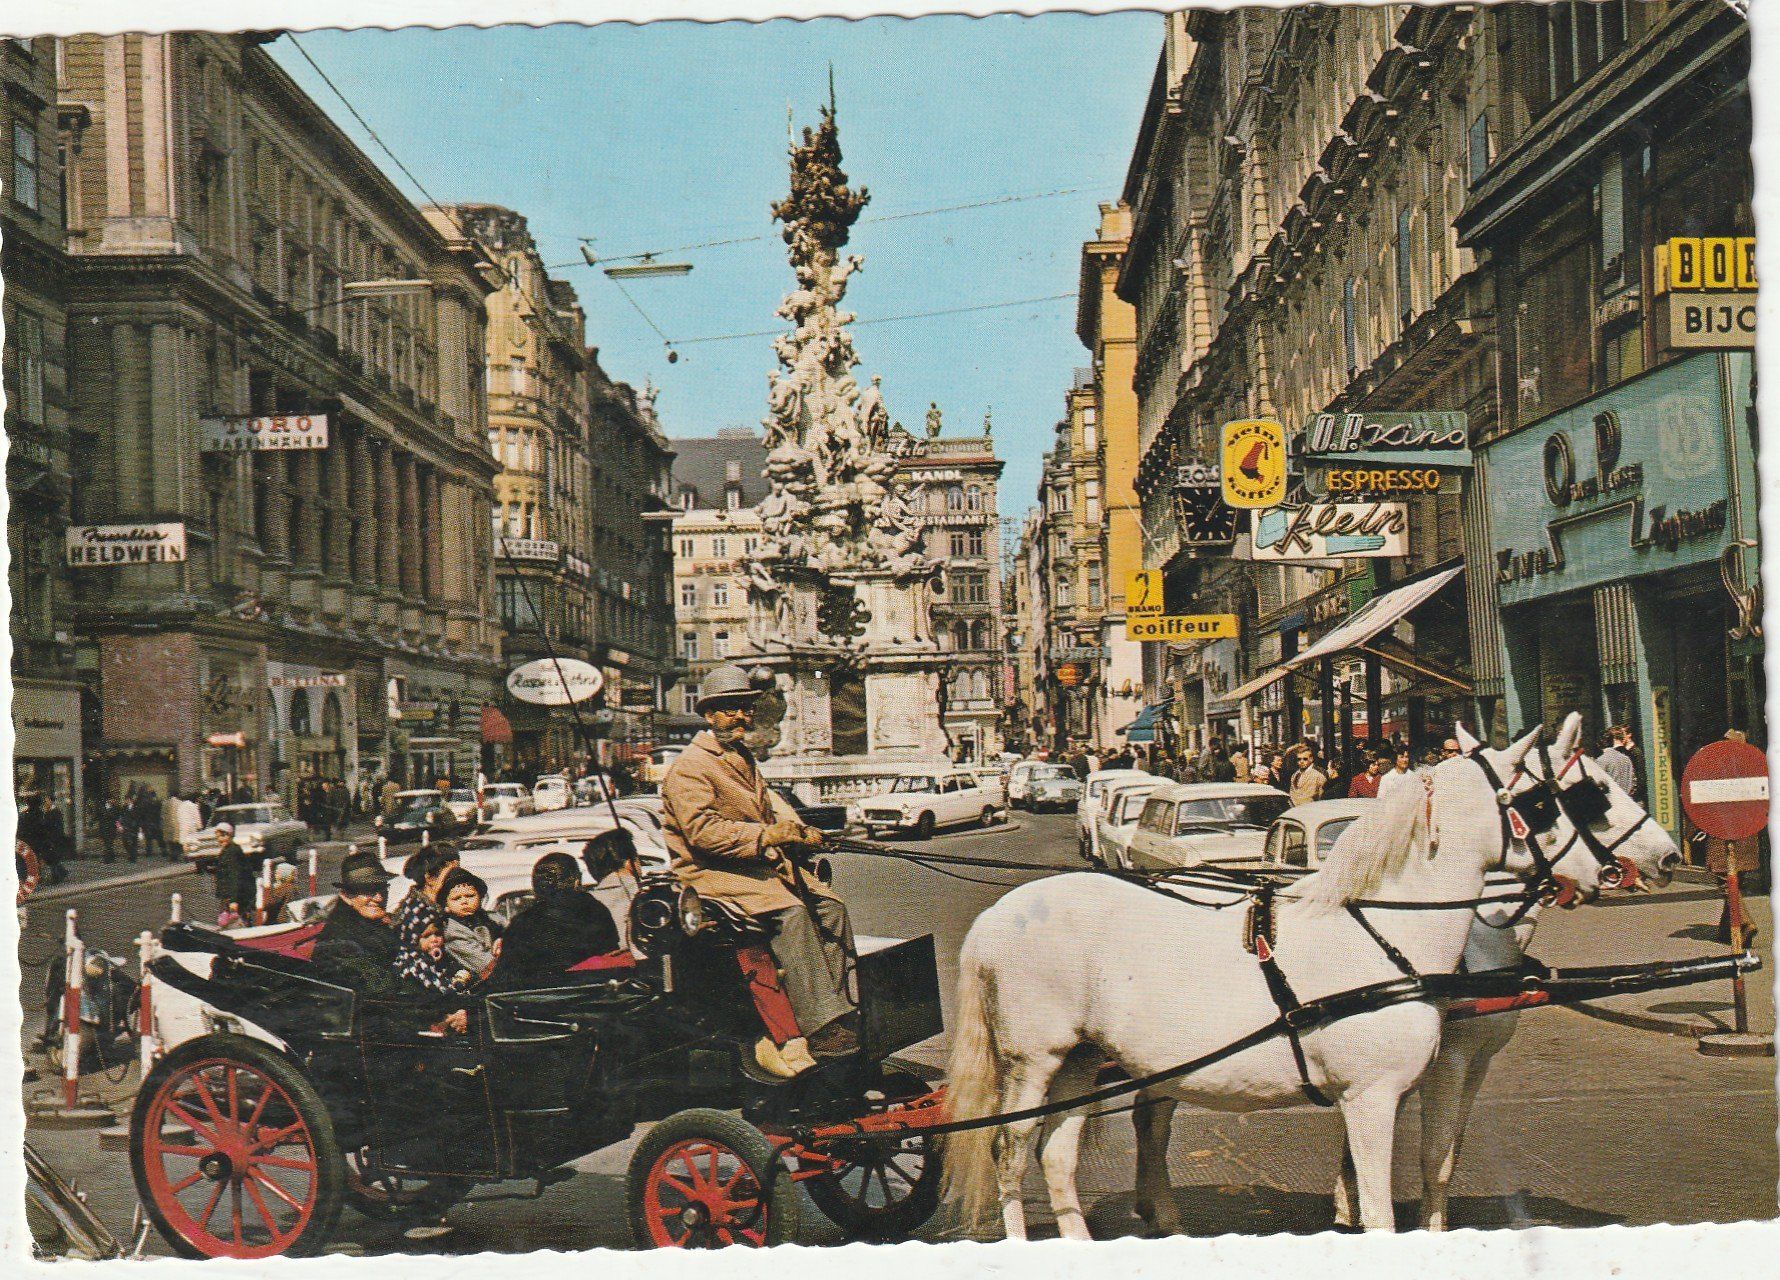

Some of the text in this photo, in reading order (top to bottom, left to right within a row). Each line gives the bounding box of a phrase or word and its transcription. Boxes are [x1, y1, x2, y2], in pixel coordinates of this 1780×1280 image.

[1685, 306, 1756, 333] BIJO
[224, 414, 312, 435] TORO
[1365, 421, 1466, 446] Kino
[1327, 469, 1440, 491] ESPRESSO
[1258, 501, 1406, 556] Klein
[70, 544, 182, 563] HELDWEIN
[1133, 619, 1220, 635] coiffeur
